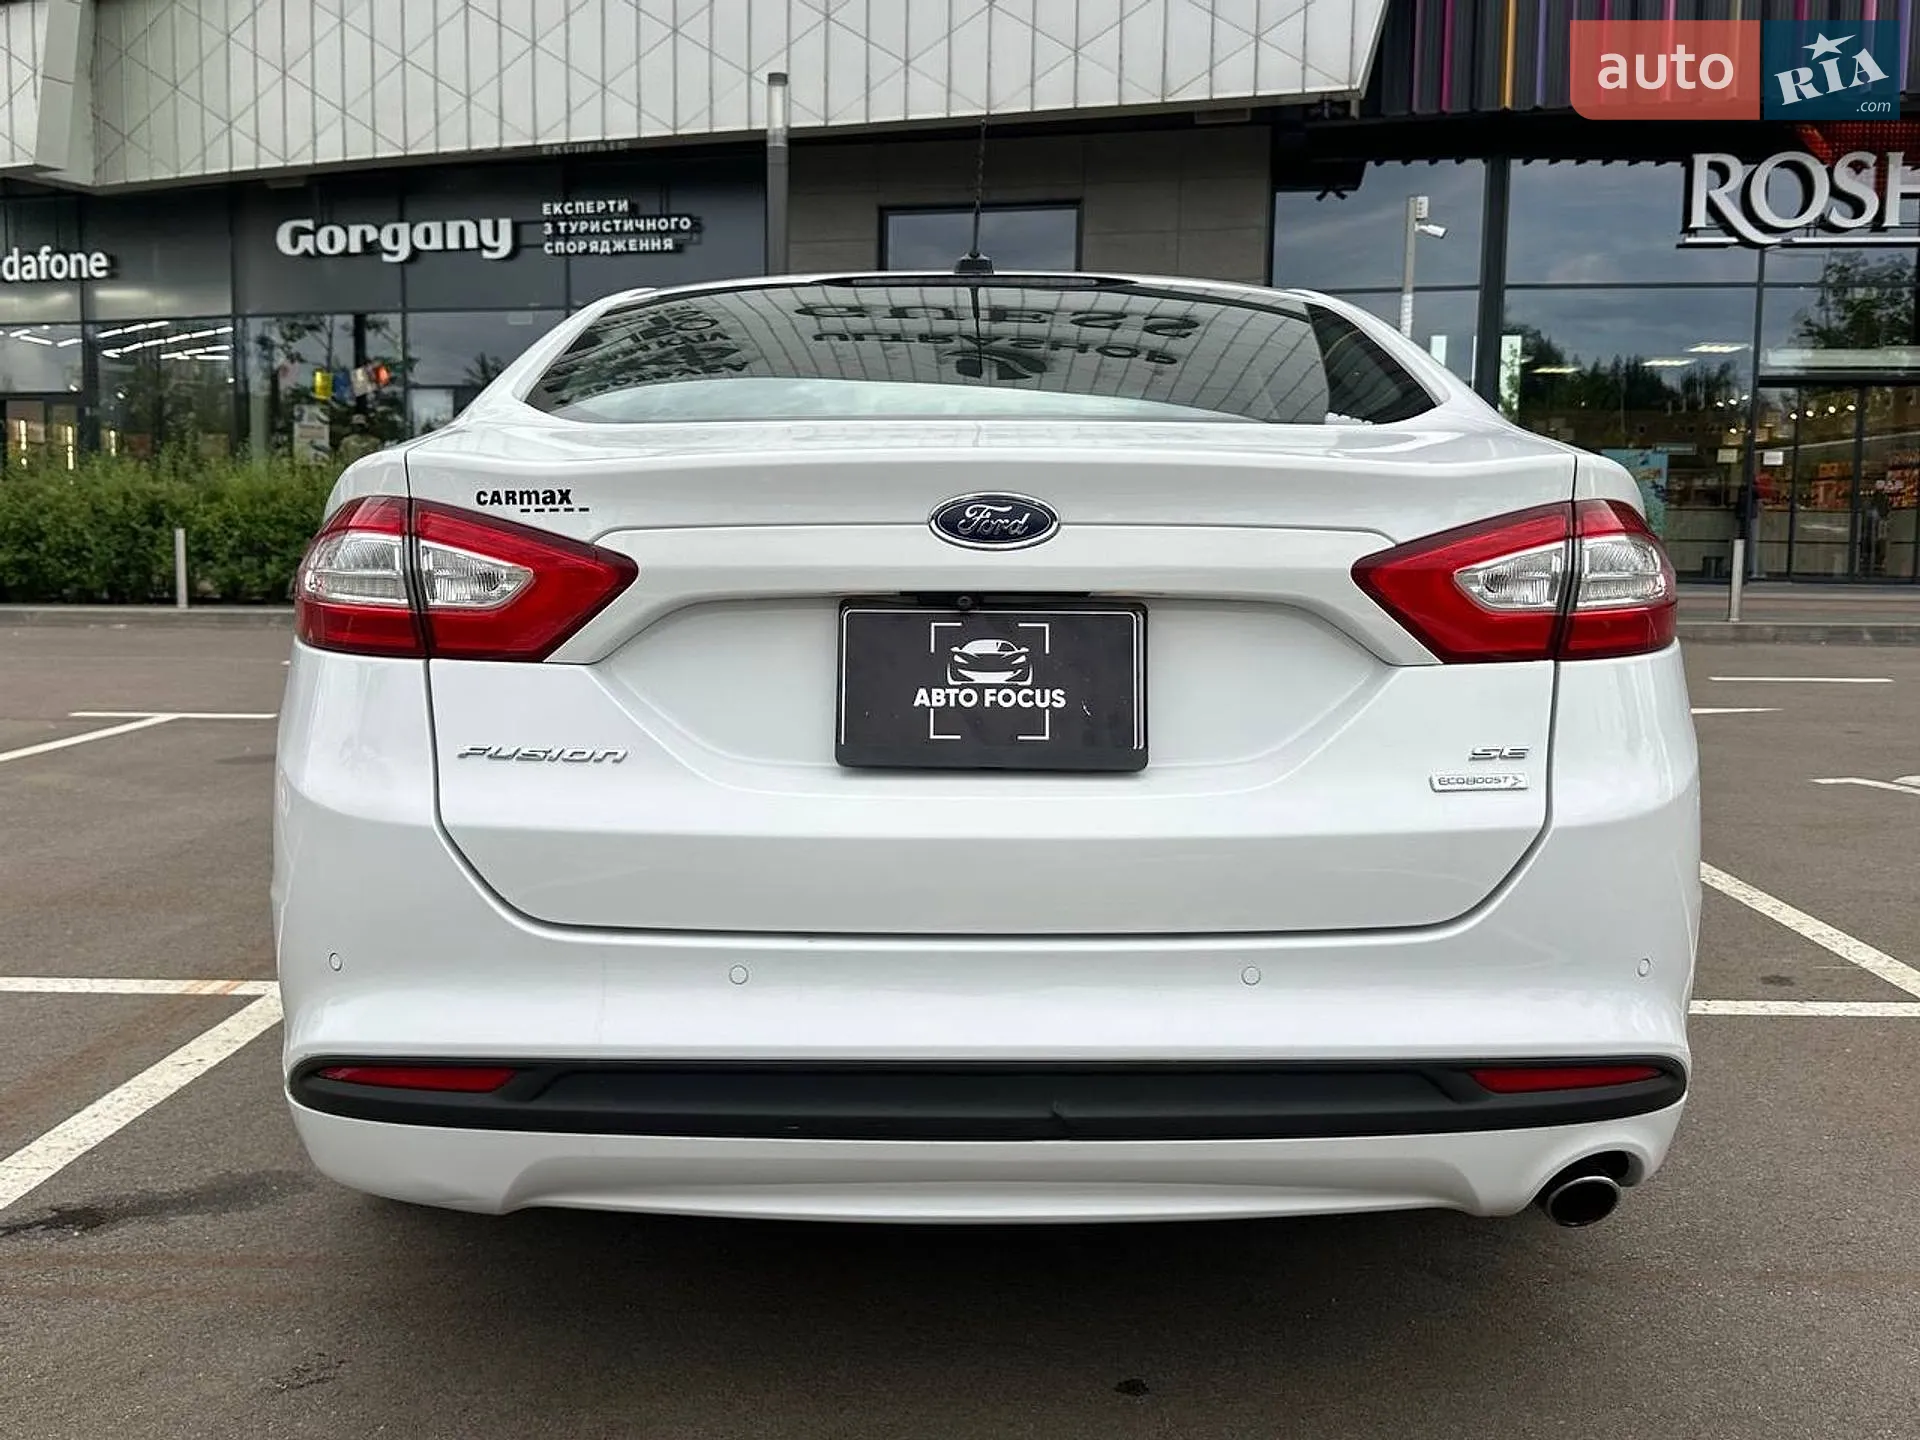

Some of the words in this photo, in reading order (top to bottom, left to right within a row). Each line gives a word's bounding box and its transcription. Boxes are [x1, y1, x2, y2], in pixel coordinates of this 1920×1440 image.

[541, 199, 630, 216] ЕКСПЕРТИ
[558, 216, 693, 235] ТУРИСТИЧНОГО
[276, 218, 513, 263] Gorgany
[543, 237, 674, 255] СПОРЯДЖЕННЯ
[956, 503, 1031, 536] Ford
[983, 688, 1067, 709] FOCUS
[1468, 746, 1531, 762] SE
